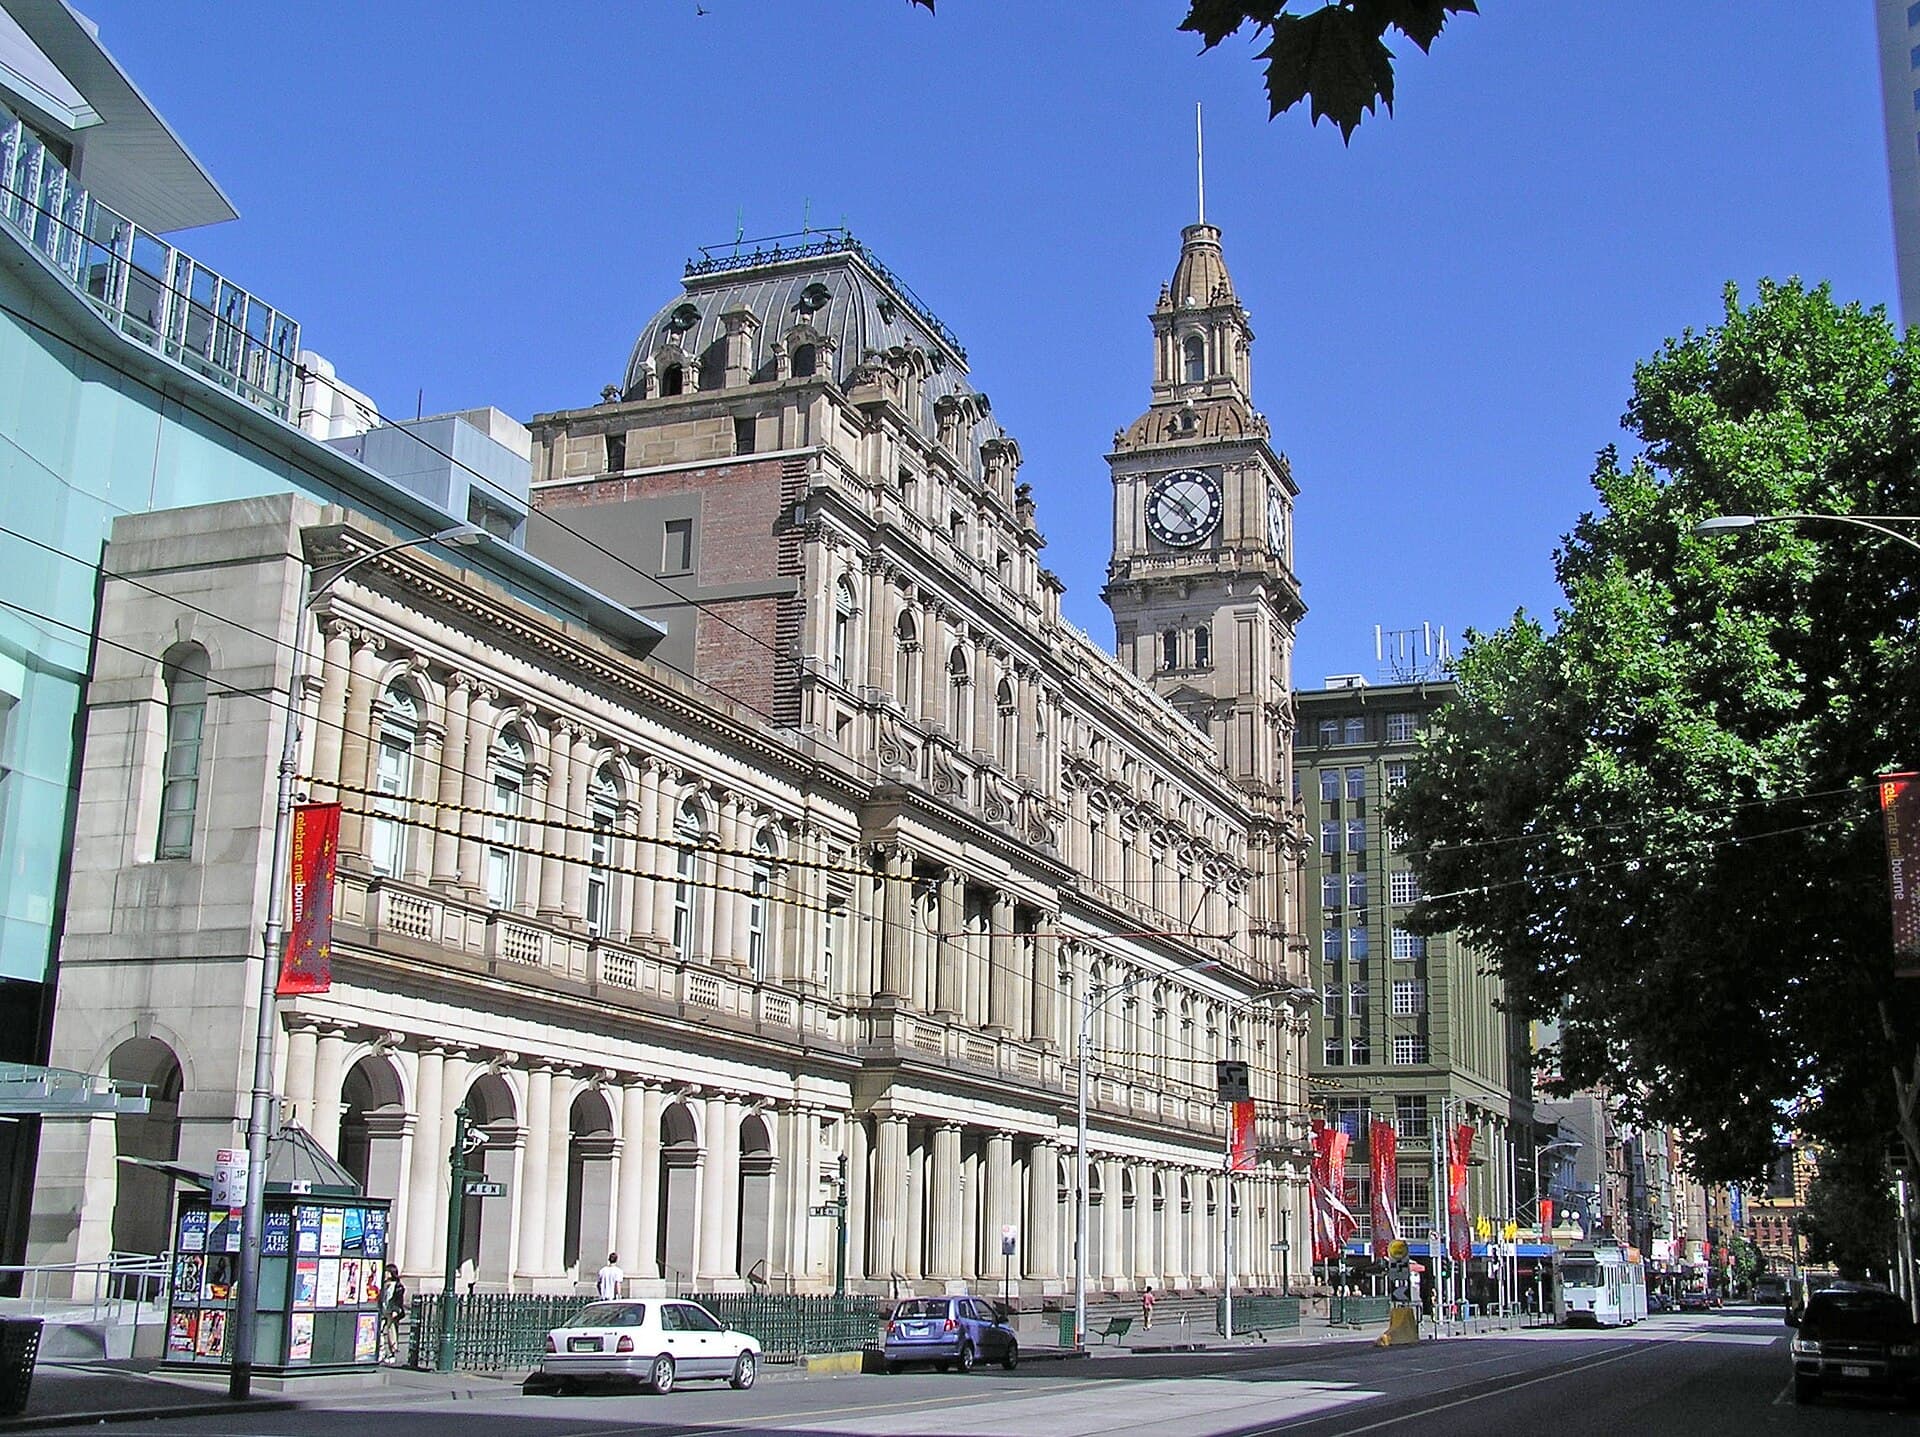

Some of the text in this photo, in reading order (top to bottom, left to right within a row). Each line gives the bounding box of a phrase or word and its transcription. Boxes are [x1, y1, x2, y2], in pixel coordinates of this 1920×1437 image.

[1884, 782, 1900, 835] celebrate
[294, 811, 307, 923] celebrate melbourne
[469, 1185, 498, 1193] MEN
[183, 1215, 207, 1224] AGE
[267, 1218, 290, 1226] AGE
